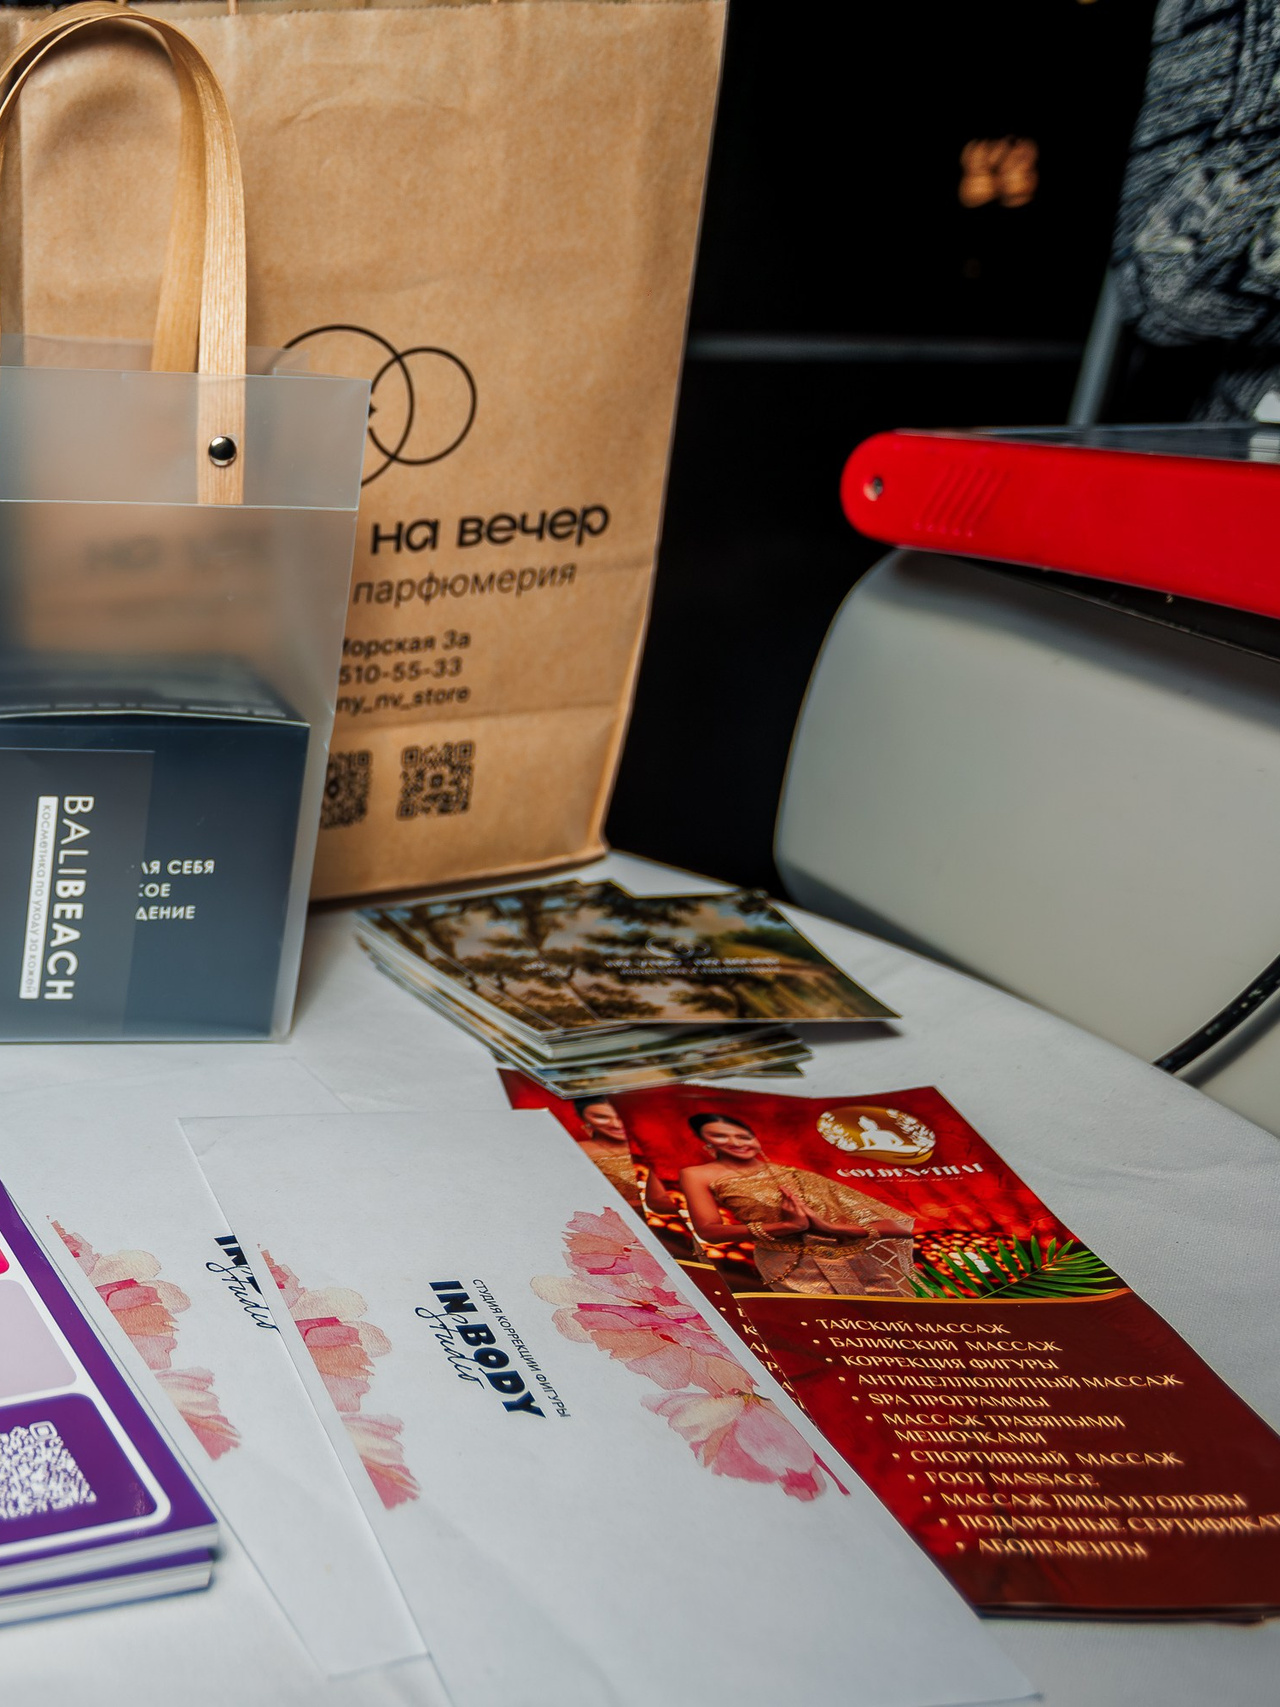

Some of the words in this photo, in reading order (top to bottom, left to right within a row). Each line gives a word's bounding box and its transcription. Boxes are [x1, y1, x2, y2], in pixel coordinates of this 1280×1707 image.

[370, 518, 440, 555] на
[456, 503, 611, 549] вечер
[352, 562, 577, 608] парфюмерия
[167, 859, 215, 875] СЕБЯ
[44, 796, 94, 1000] BALIBEACH
[135, 905, 196, 921] ДЕНИЕ
[816, 1318, 913, 1333] ТАЙСКИЙ
[915, 1322, 1011, 1335] МАССАЖ
[429, 1281, 478, 1314] IN
[455, 1323, 546, 1418] BODY
[472, 1278, 503, 1314] СТУДИЯ
[495, 1315, 542, 1372] КОРРЕКЦИИ
[535, 1373, 571, 1418] ФИГУРЫ
[828, 1336, 958, 1351] БАЛИЙСКИЙ
[964, 1339, 1063, 1353] МАССАЖ
[841, 1354, 966, 1371] КОРРЕКЦИЯ
[968, 1357, 1060, 1370] ФИГУРЫ
[858, 1374, 1081, 1390] АНТИЦЕЛЛЮЛИТНЫЙ
[1081, 1374, 1184, 1388] МАССАЖ
[868, 1393, 911, 1406] SPA
[910, 1394, 1051, 1409] ПРОГРАММЫ
[882, 1412, 985, 1427] МАССАЖ
[984, 1413, 1126, 1429] ТРАВЯНЫМИ
[894, 1429, 1047, 1446] МЕШОЧКАМИ
[910, 1450, 1069, 1466] СПОРТИВНЫЙ
[1075, 1451, 1185, 1467] МАССАЖ
[924, 1470, 985, 1486] FOOT
[988, 1472, 1100, 1488] MASSAGE
[940, 1492, 1051, 1508] МАССАЖ
[1051, 1494, 1121, 1512] ЛИЦА
[1120, 1495, 1142, 1510] И
[1141, 1494, 1247, 1511] ГОЛОВЫ
[957, 1515, 1125, 1533] ПОДАРОЧНЫЕ
[978, 1538, 1148, 1557] АБОНЕМЕНТЫ
